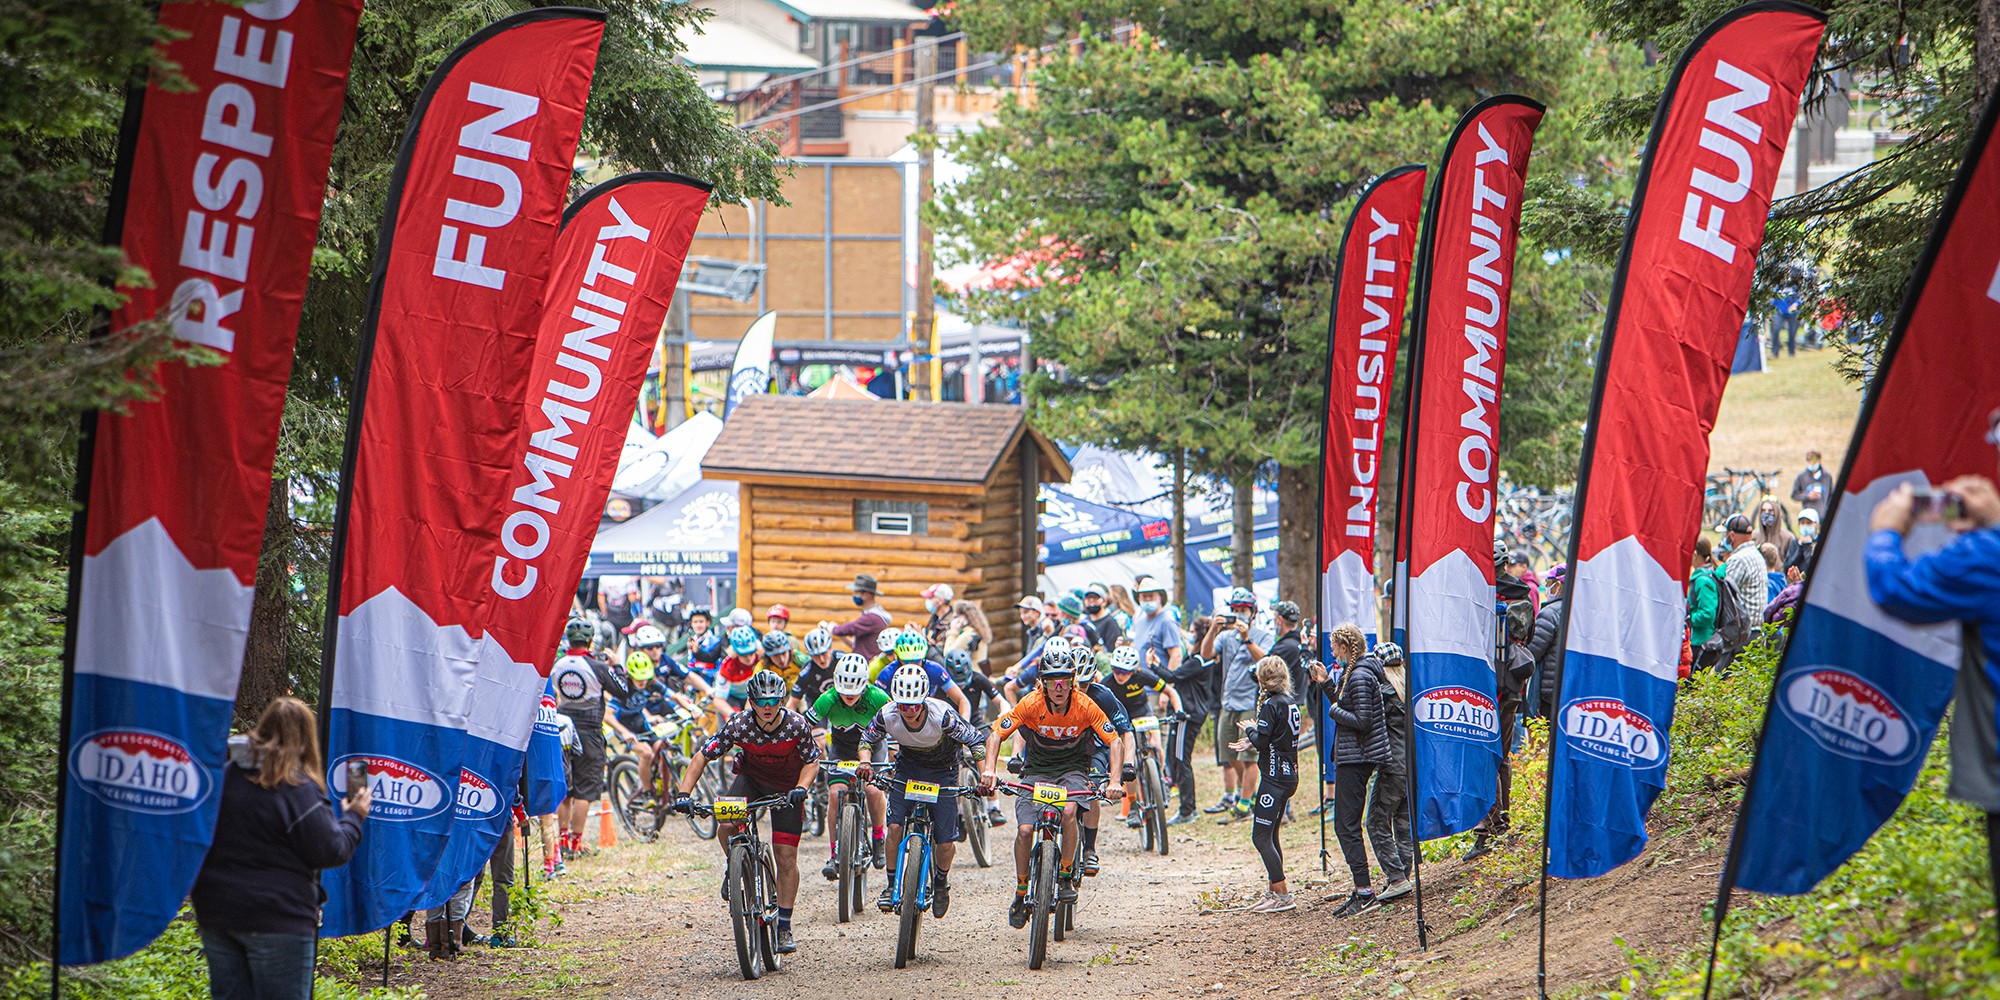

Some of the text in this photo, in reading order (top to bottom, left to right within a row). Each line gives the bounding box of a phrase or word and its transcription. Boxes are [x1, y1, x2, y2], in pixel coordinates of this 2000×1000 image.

[1679, 59, 1770, 264] FUN
[433, 81, 540, 290] FUN
[1456, 121, 1509, 524] COMMUNITY
[1346, 207, 1400, 538] INCLUSIVITY
[491, 195, 650, 600] COMMUNITY
[1141, 520, 1170, 540] NICA
[613, 551, 729, 563] MIDDLETON VIKINGS
[640, 563, 702, 575] MTB TEAM
[1429, 689, 1494, 709] INTERSCHOLASTIC
[1427, 703, 1493, 730] IDAHO
[1038, 725, 1079, 738] TVC
[1434, 722, 1490, 738] CYCLING LEAGUE
[1576, 715, 1647, 754] IDAO
[1581, 739, 1620, 756] CYCLING
[96, 752, 189, 794] IDAHO
[372, 778, 423, 805] AHO
[912, 784, 932, 792] 804
[1040, 789, 1061, 800] 909
[384, 804, 414, 816] LEAGUE
